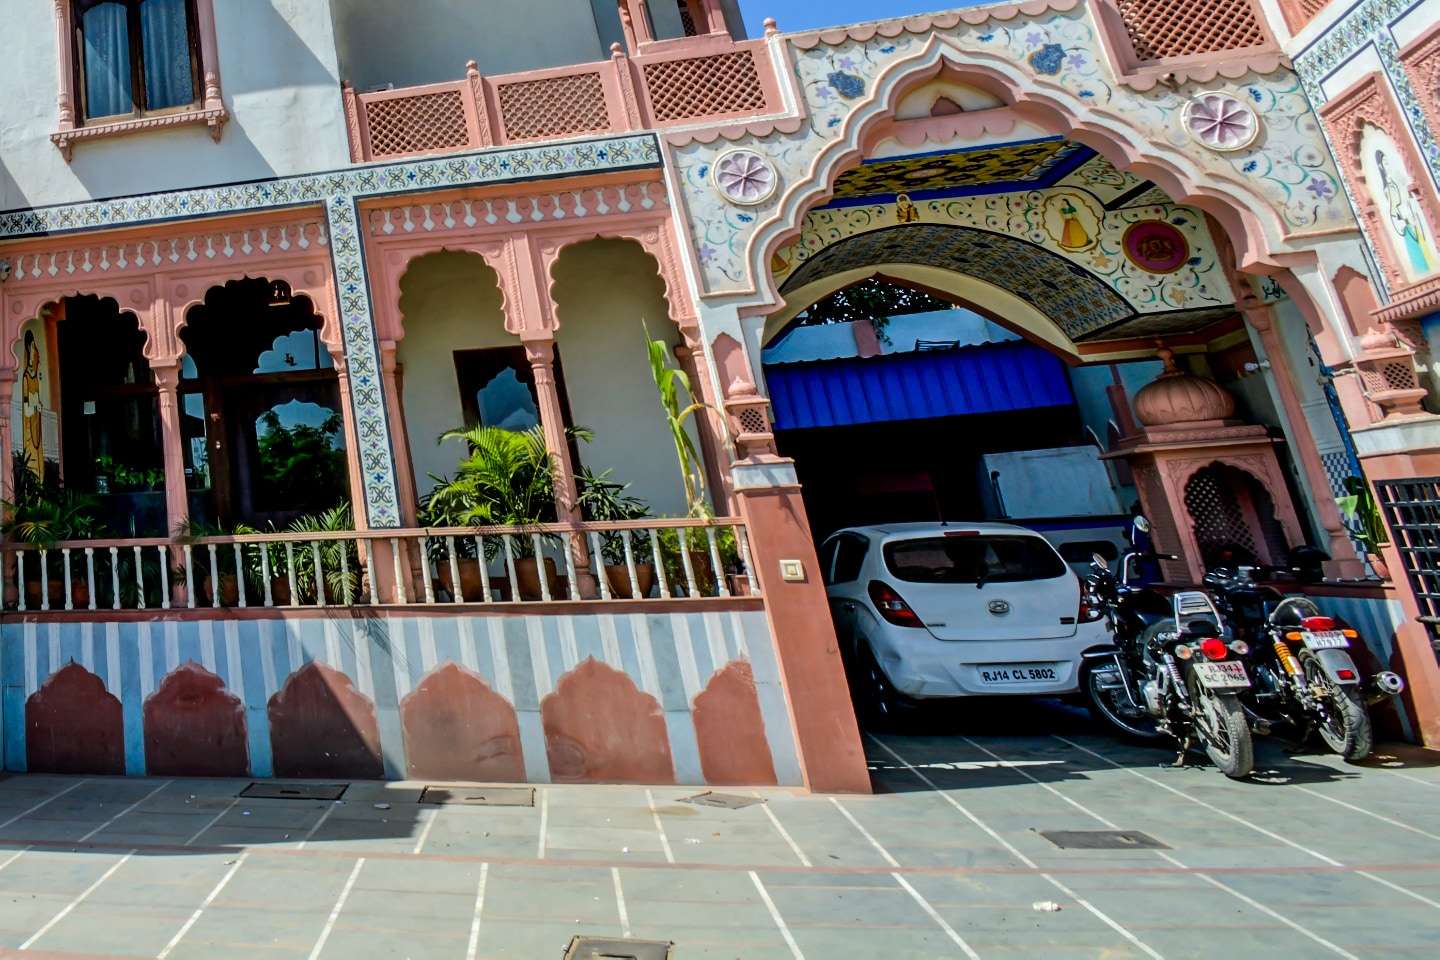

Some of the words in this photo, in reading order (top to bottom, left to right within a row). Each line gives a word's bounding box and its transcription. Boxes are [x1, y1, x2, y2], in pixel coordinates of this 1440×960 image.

[982, 670, 1010, 682] RJ14
[1012, 669, 1028, 680] CL
[1028, 668, 1056, 680] 5802
